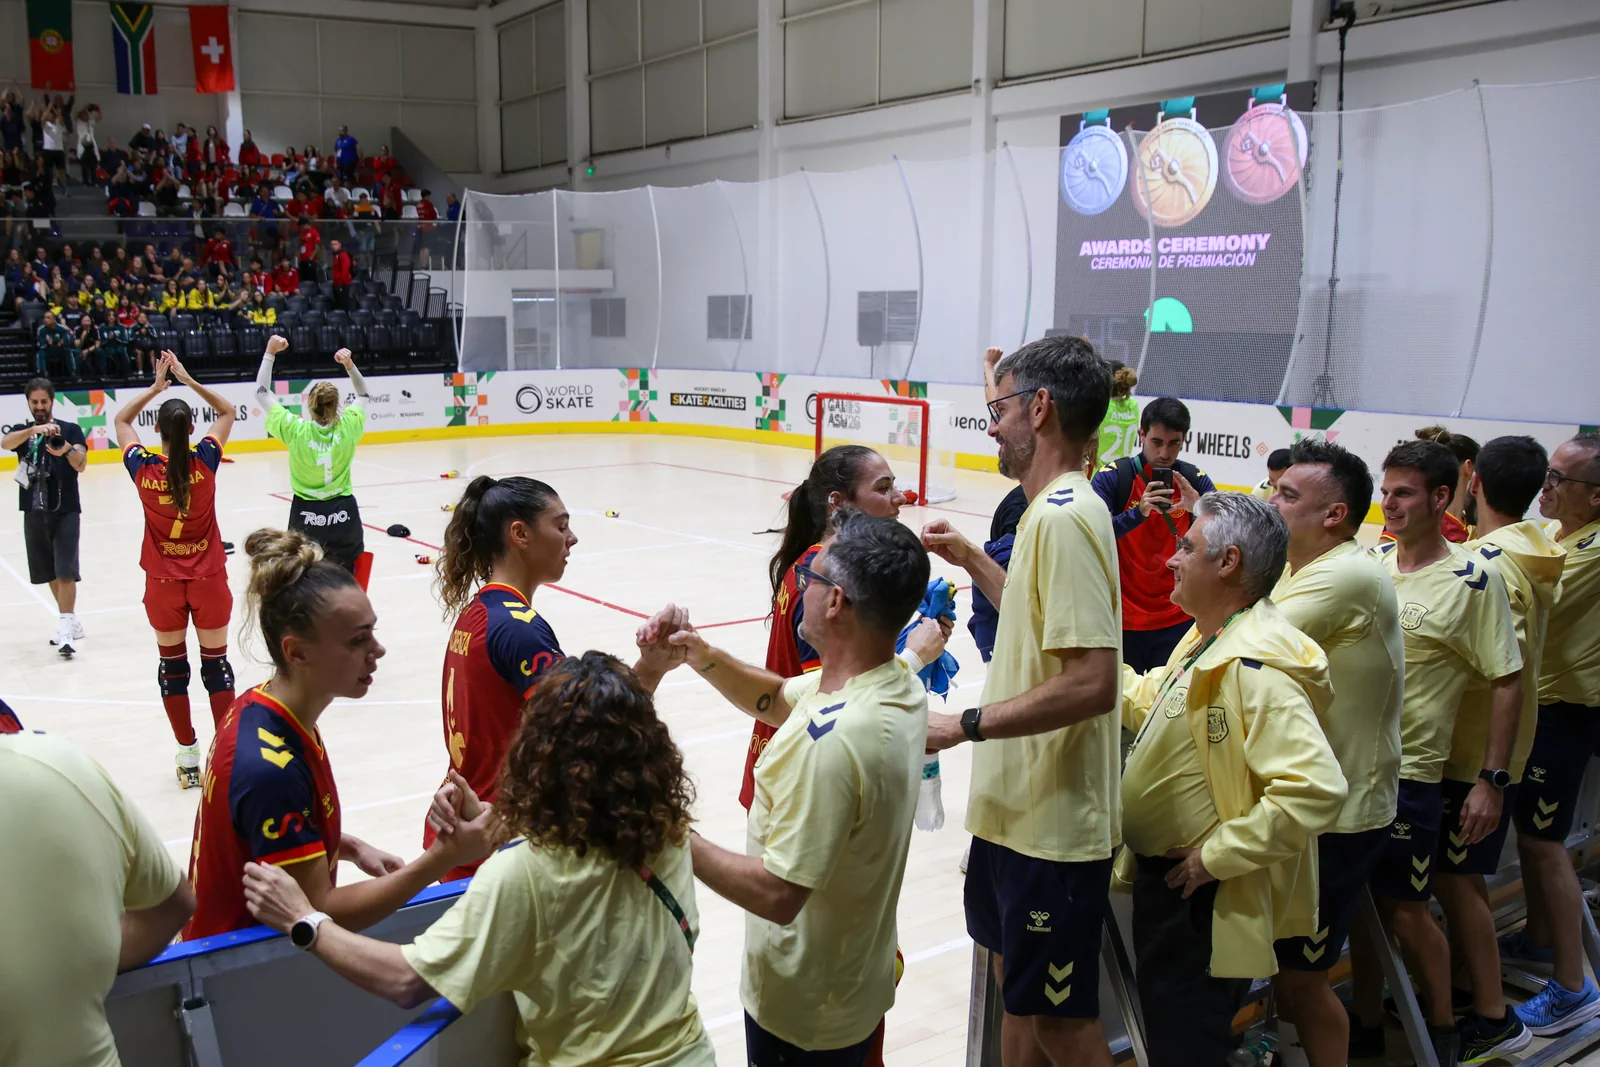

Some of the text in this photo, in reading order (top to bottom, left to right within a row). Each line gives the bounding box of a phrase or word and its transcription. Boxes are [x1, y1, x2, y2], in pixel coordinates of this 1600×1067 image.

[1080, 233, 1271, 256] AWARDS CEREMONY
[1158, 254, 1175, 268] DE
[1176, 250, 1256, 267] PREMIACIÓN
[545, 384, 594, 397] WORLD
[546, 396, 594, 410] SKATE
[672, 394, 745, 409] SKATEFACILITIES
[1197, 431, 1252, 459] WHEELS
[316, 454, 333, 488] 1
[160, 538, 208, 555] Reno
